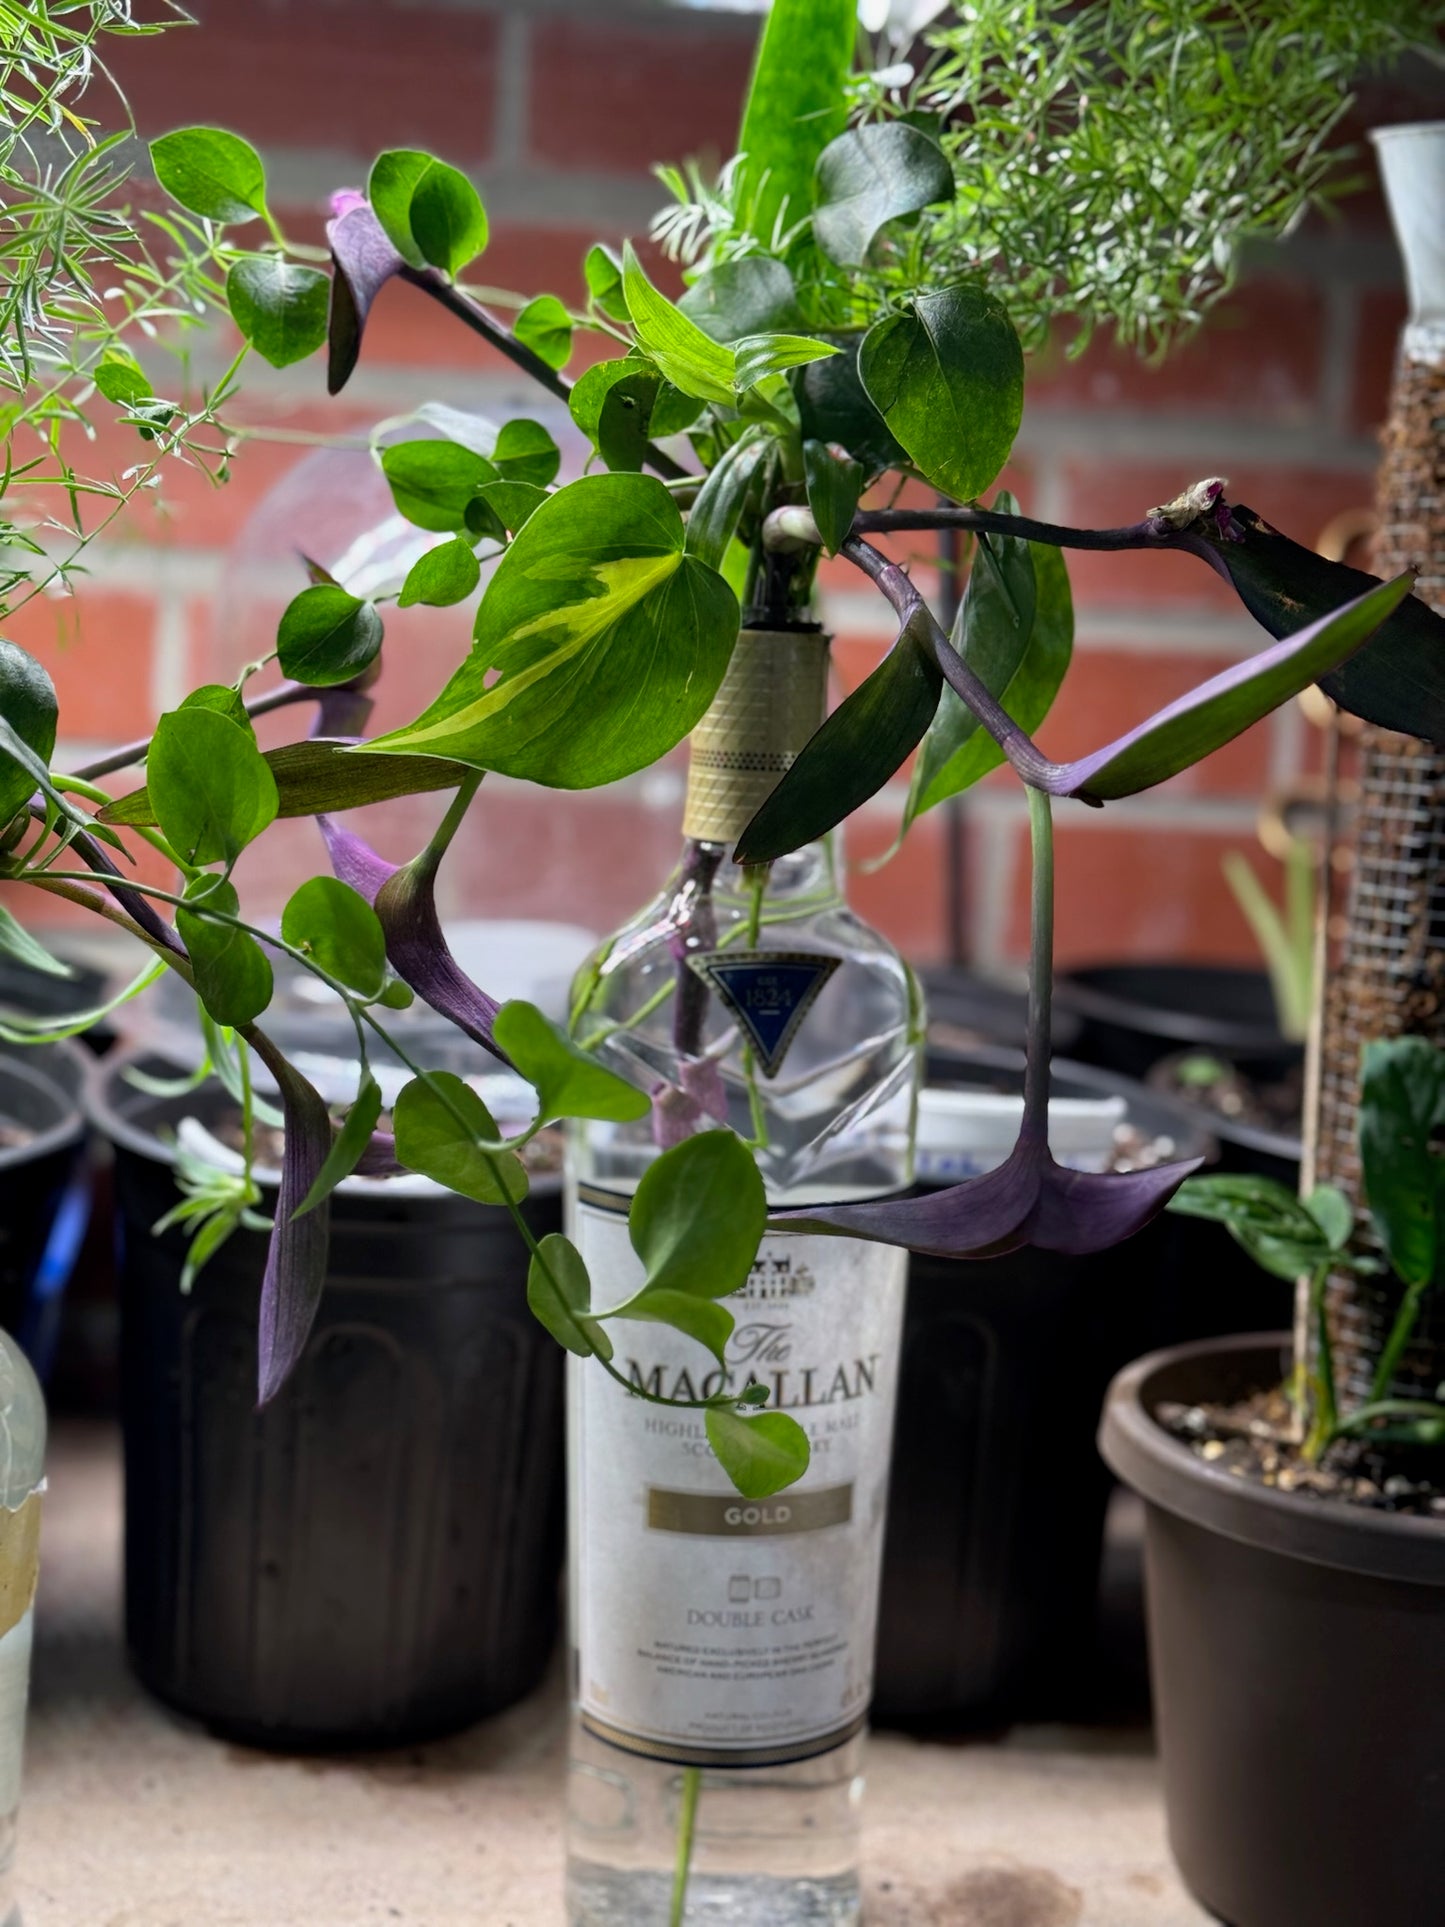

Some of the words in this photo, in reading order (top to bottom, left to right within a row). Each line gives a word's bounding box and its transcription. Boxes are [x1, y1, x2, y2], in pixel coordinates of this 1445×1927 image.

[745, 988, 792, 1007] 1824
[724, 1322, 793, 1365] The
[625, 1355, 880, 1410] MACALLAN
[645, 1417, 708, 1441] HIGHL
[724, 1505, 792, 1525] GOLD
[687, 1608, 765, 1628] DOUBLE
[771, 1604, 815, 1624] CASK
